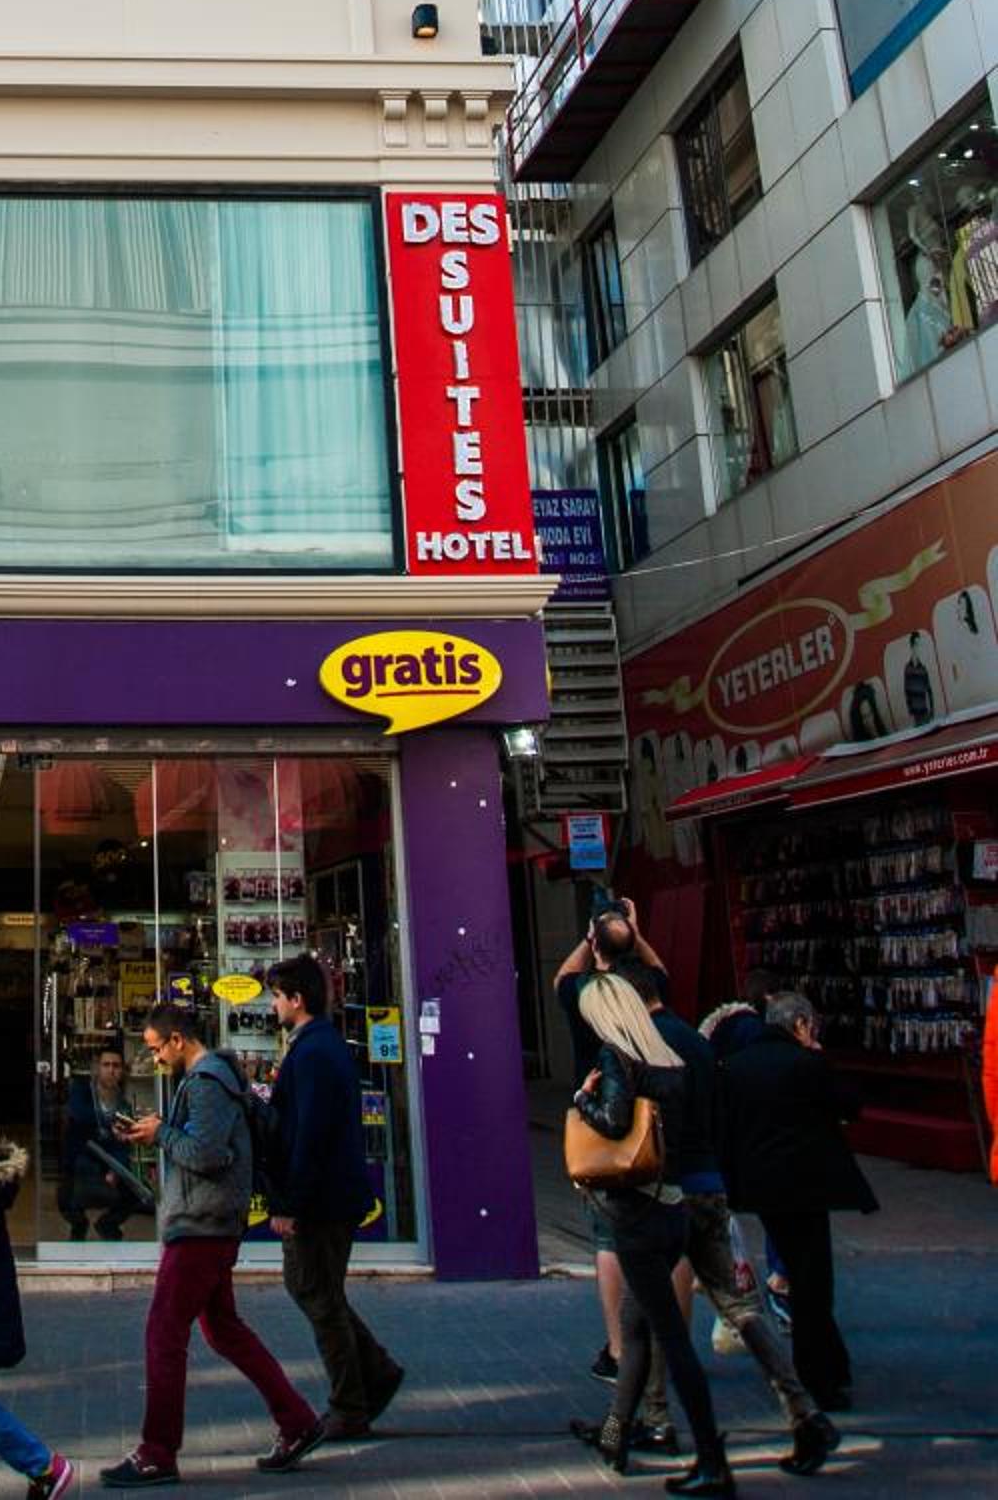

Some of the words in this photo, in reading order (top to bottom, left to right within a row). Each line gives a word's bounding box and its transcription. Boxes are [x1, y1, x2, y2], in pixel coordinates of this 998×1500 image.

[403, 202, 499, 245] DES
[533, 497, 560, 517] EYAZ
[416, 531, 532, 562] HOTEL
[341, 642, 483, 698] gratis
[715, 625, 835, 707] YETERLER
